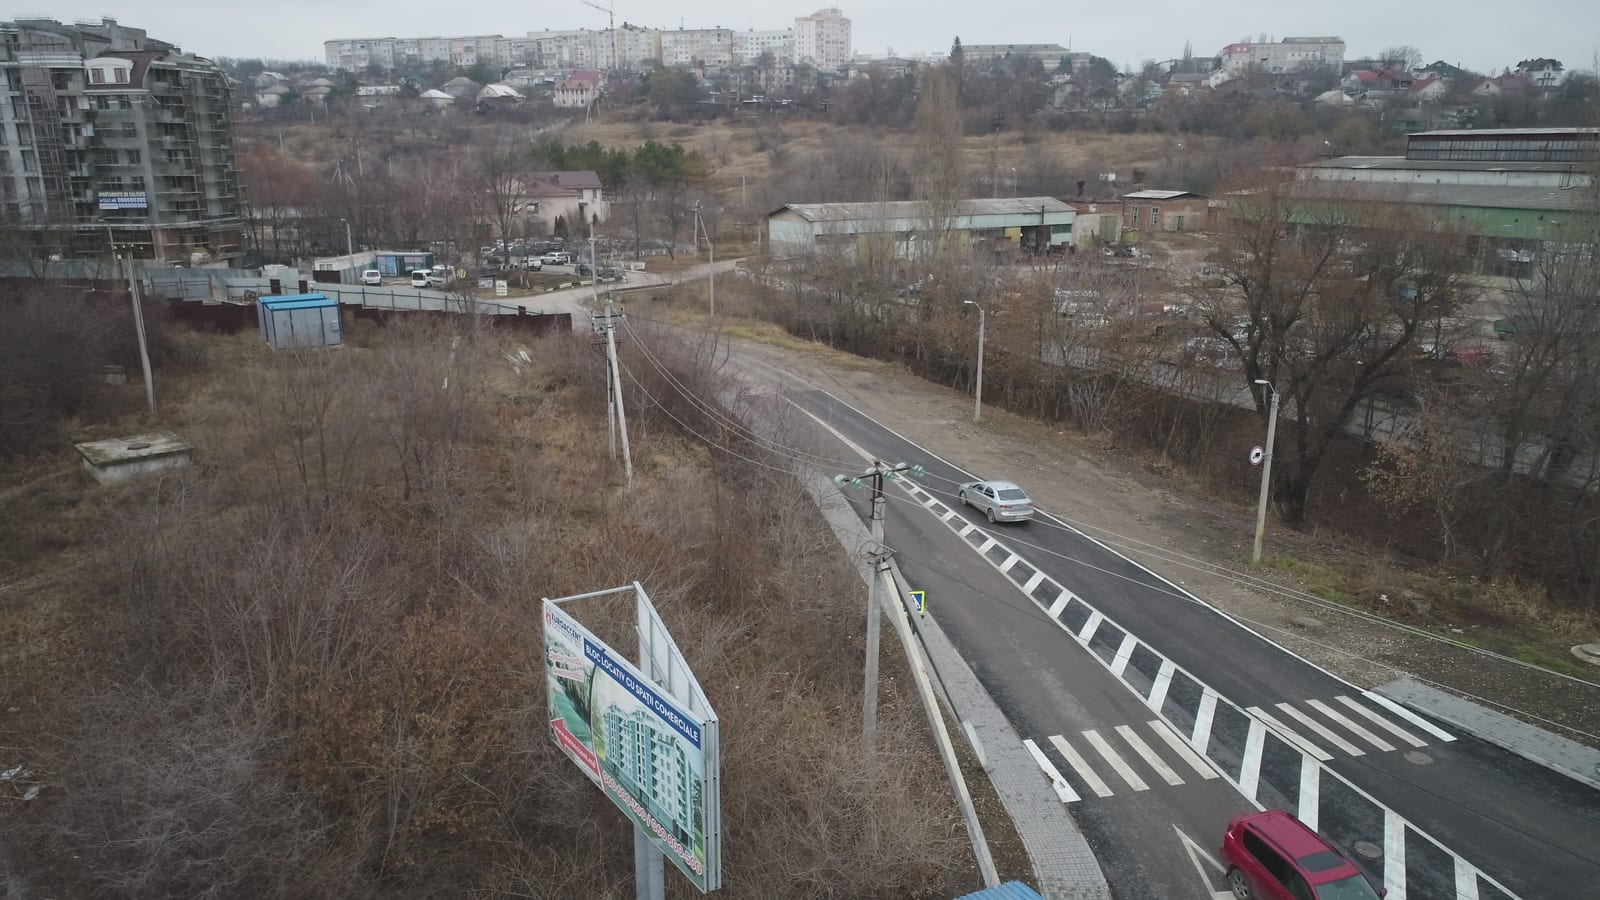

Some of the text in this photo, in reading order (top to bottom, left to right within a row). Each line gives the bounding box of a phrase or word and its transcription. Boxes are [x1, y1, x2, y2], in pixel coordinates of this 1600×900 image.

[552, 613, 582, 641] EUROACCENT
[585, 644, 601, 663] BLOC
[601, 657, 625, 682] LOCATIV
[625, 677, 635, 690] CU
[655, 700, 699, 742] COMERCIALE
